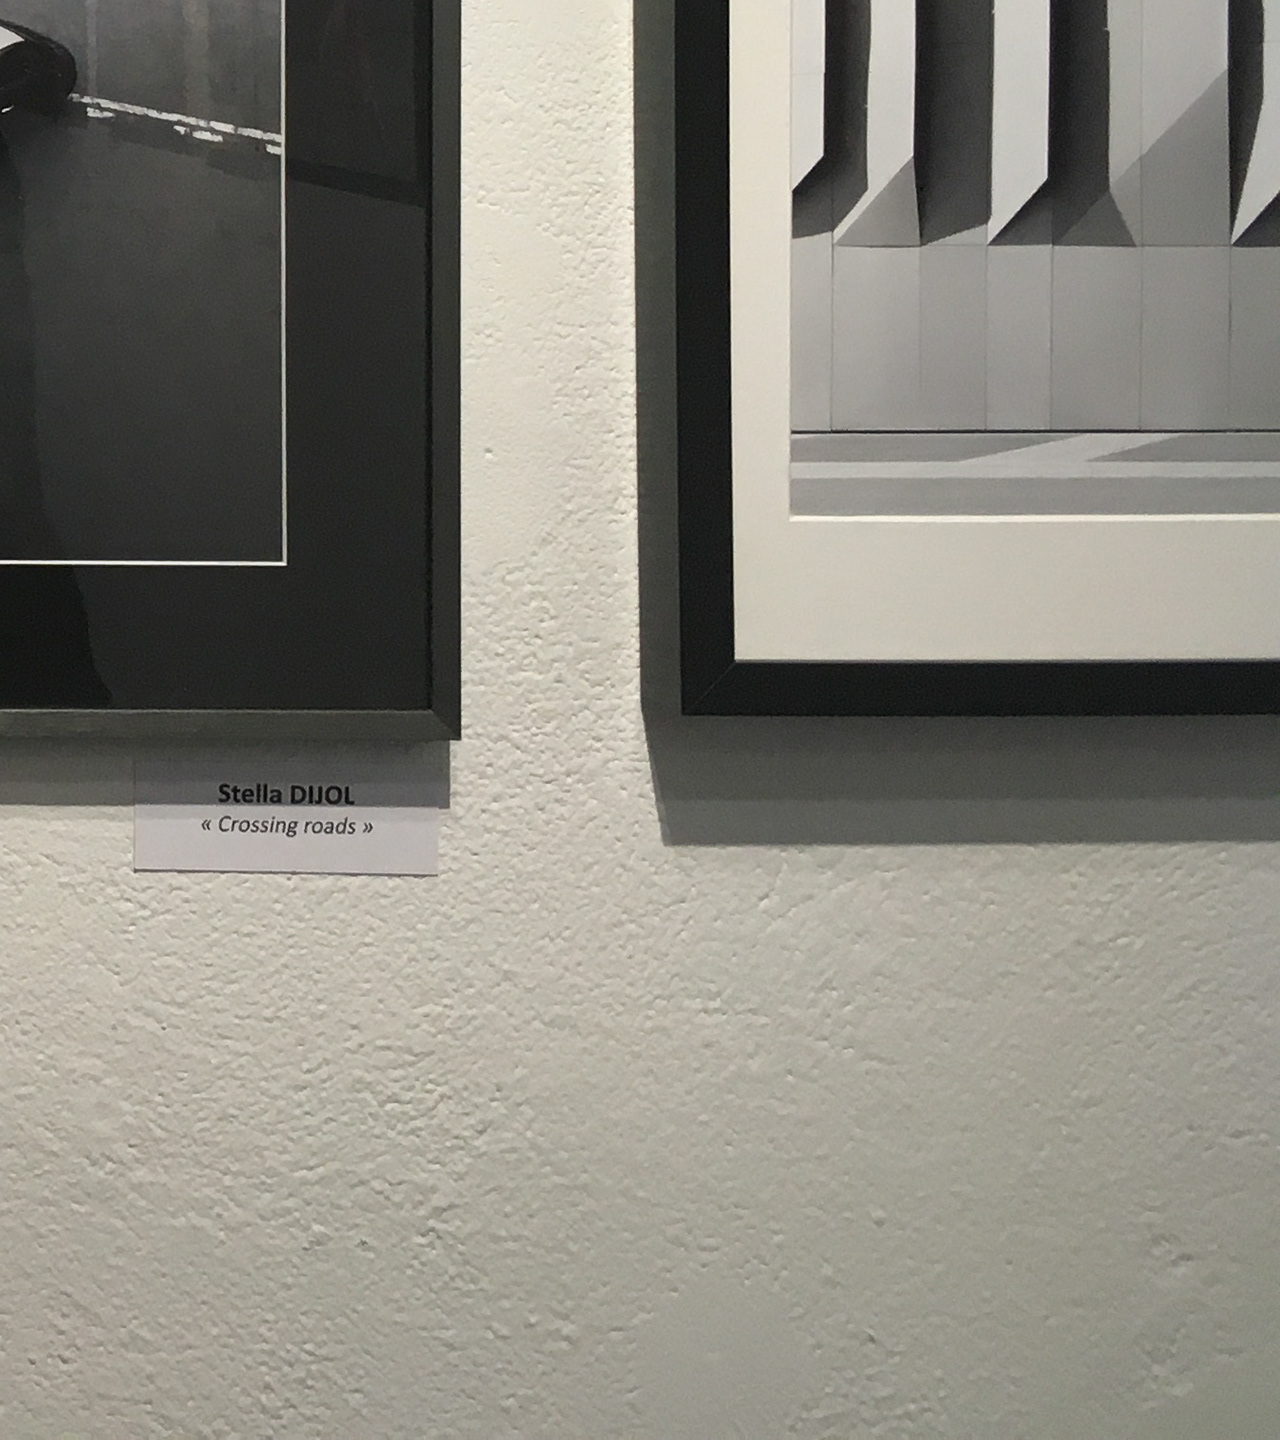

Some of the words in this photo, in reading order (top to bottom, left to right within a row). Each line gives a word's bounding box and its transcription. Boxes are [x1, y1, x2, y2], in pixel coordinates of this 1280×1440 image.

[217, 783, 282, 805] Stella
[290, 785, 356, 806] DIJOL
[218, 815, 298, 838] Crossing
[303, 817, 357, 835] roads
